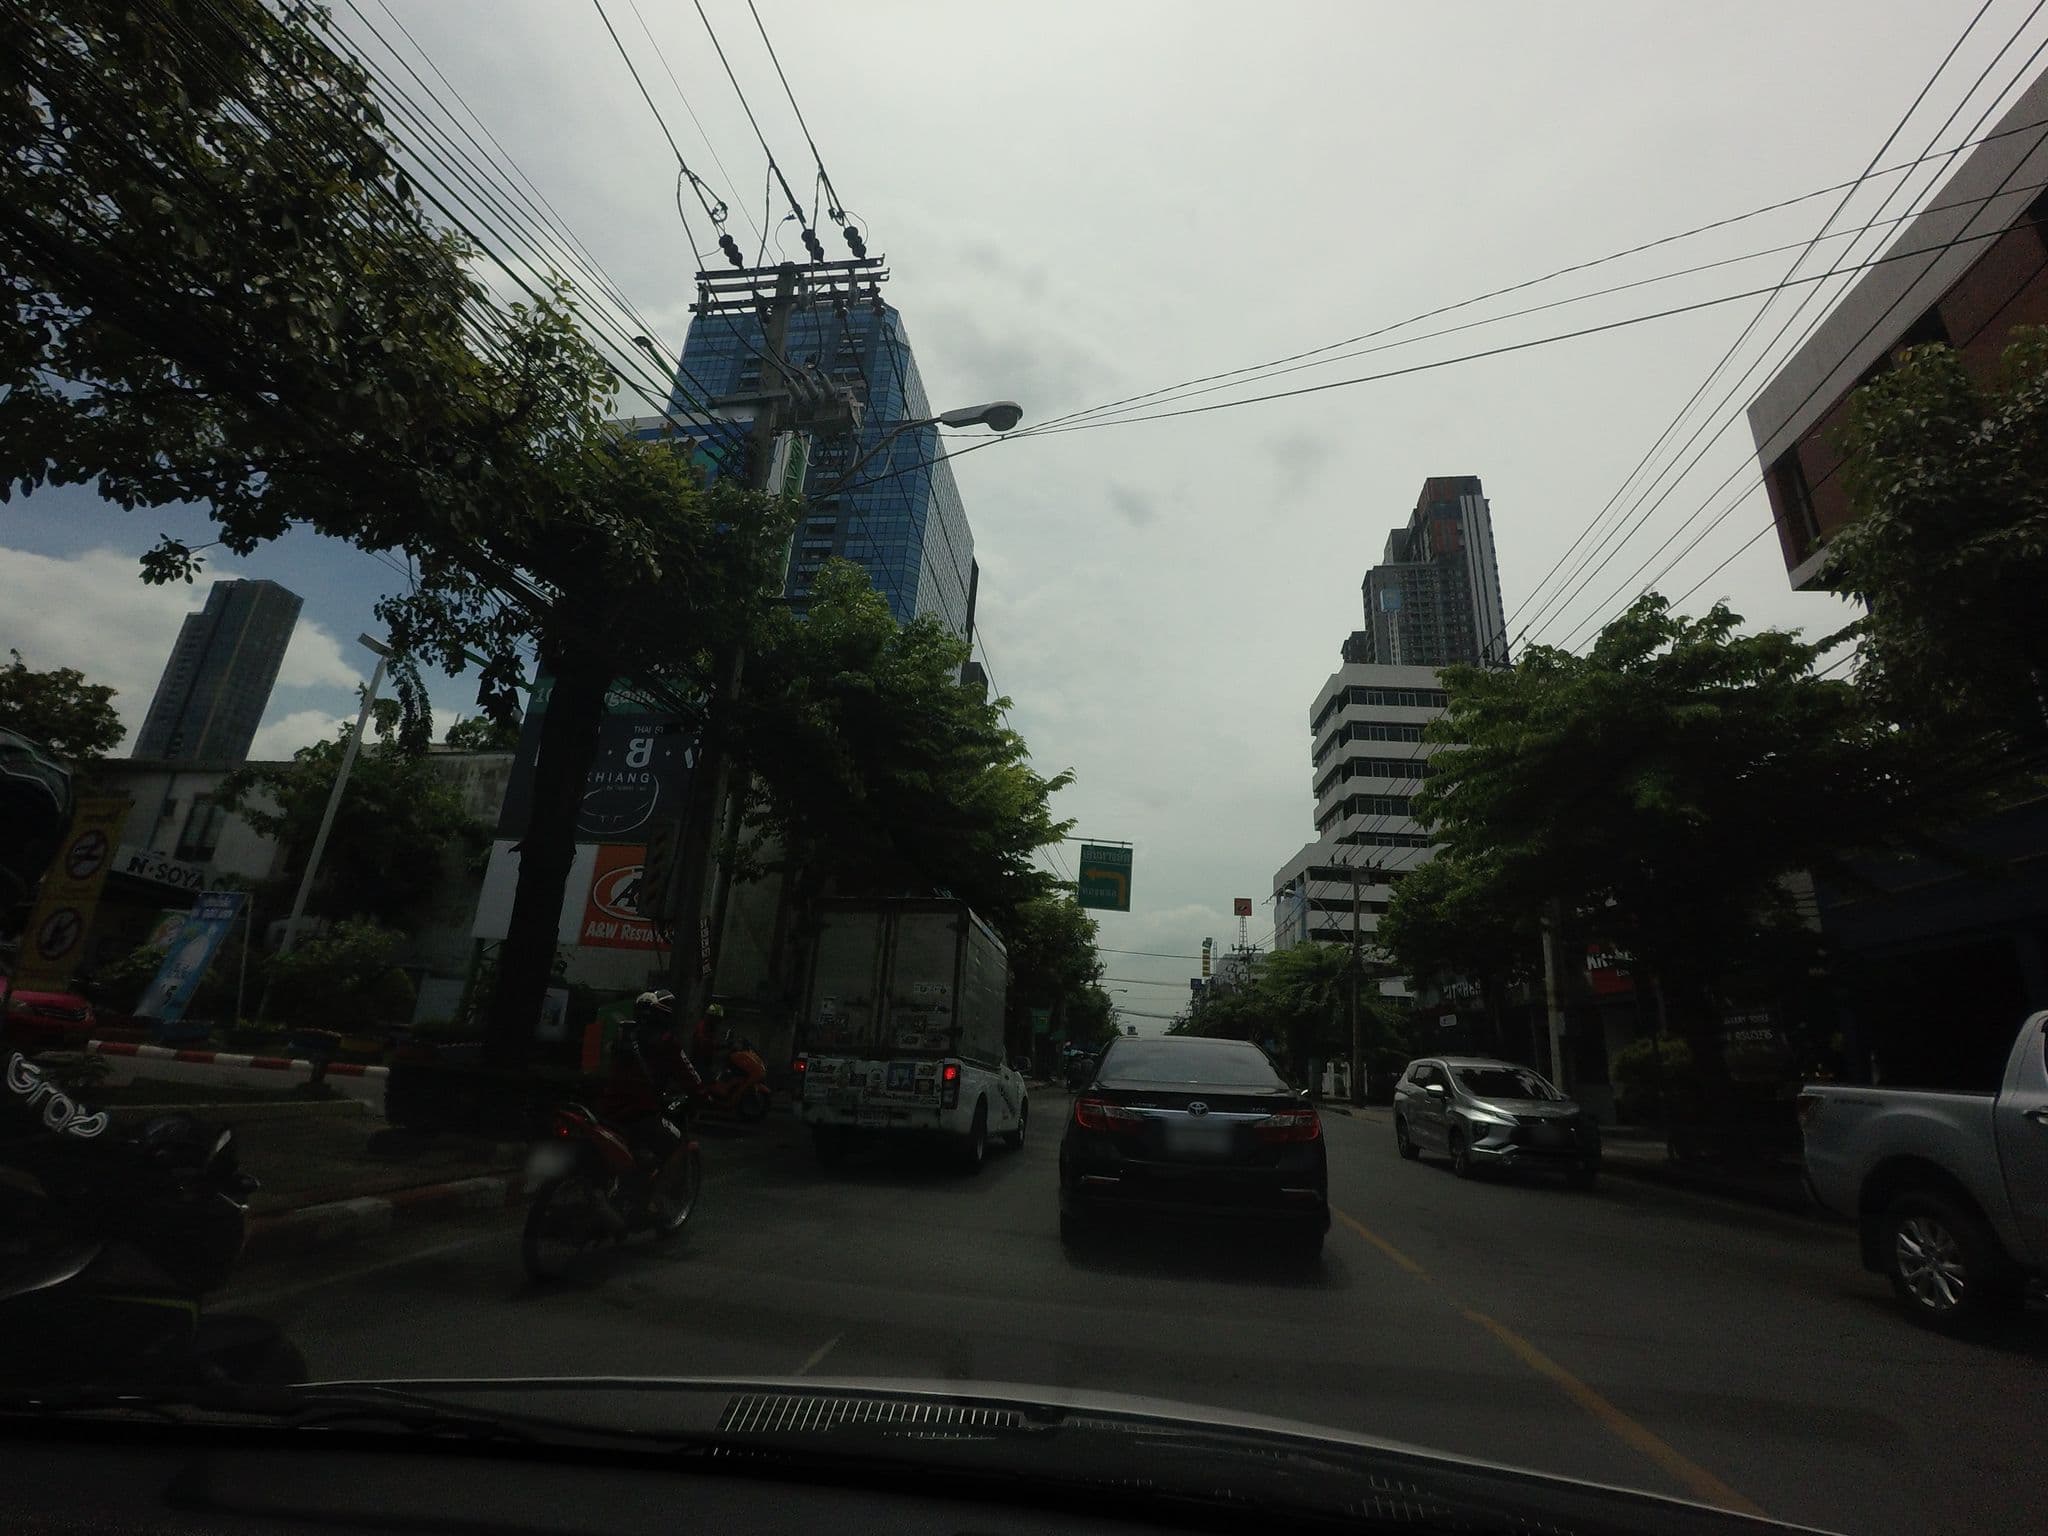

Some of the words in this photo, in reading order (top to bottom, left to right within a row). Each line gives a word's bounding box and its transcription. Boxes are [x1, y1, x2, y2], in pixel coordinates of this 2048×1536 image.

[586, 771, 651, 784] HIANG
[585, 920, 617, 940] A&W
[7, 1051, 107, 1138] Grab
